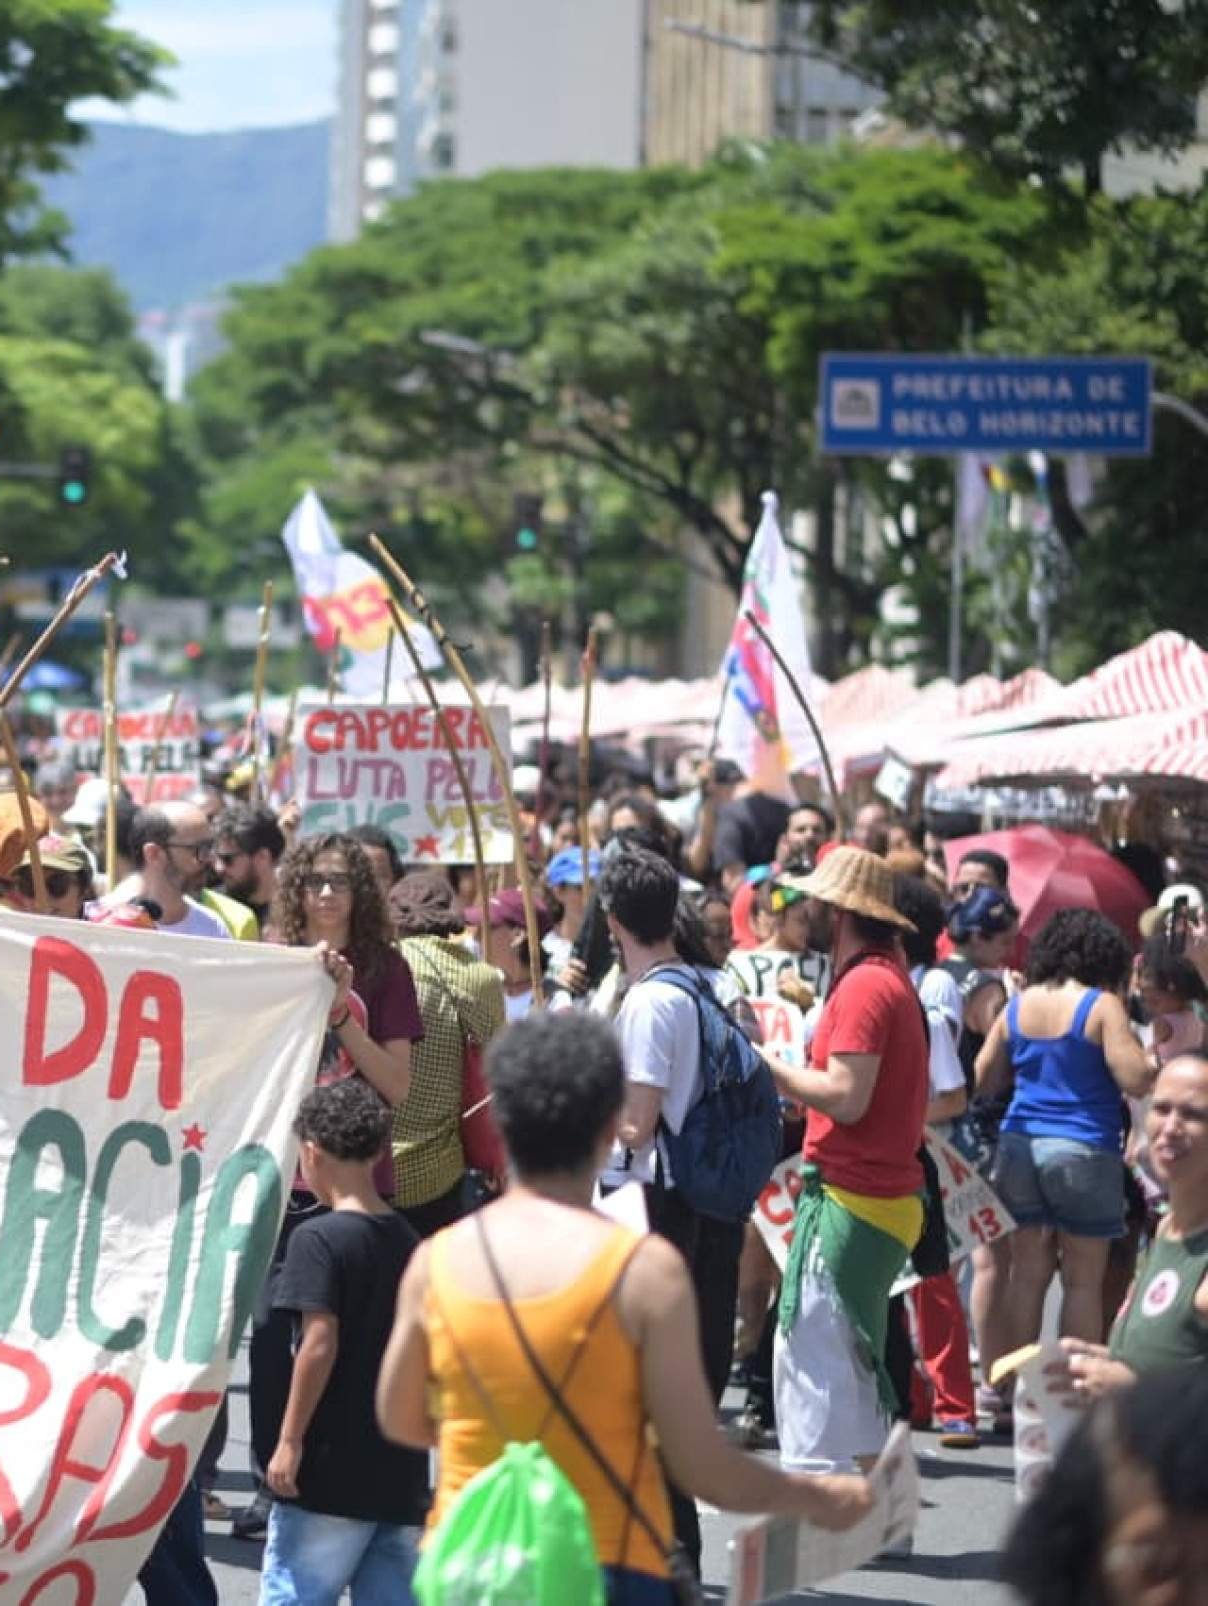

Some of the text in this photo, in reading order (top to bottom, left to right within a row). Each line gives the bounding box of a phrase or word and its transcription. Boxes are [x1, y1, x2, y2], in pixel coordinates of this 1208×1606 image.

[893, 374, 1125, 400] PREFEITURA DE
[893, 410, 1140, 437] BELO HORIZONTE
[307, 757, 407, 800] LUTA
[21, 936, 184, 1110] DA
